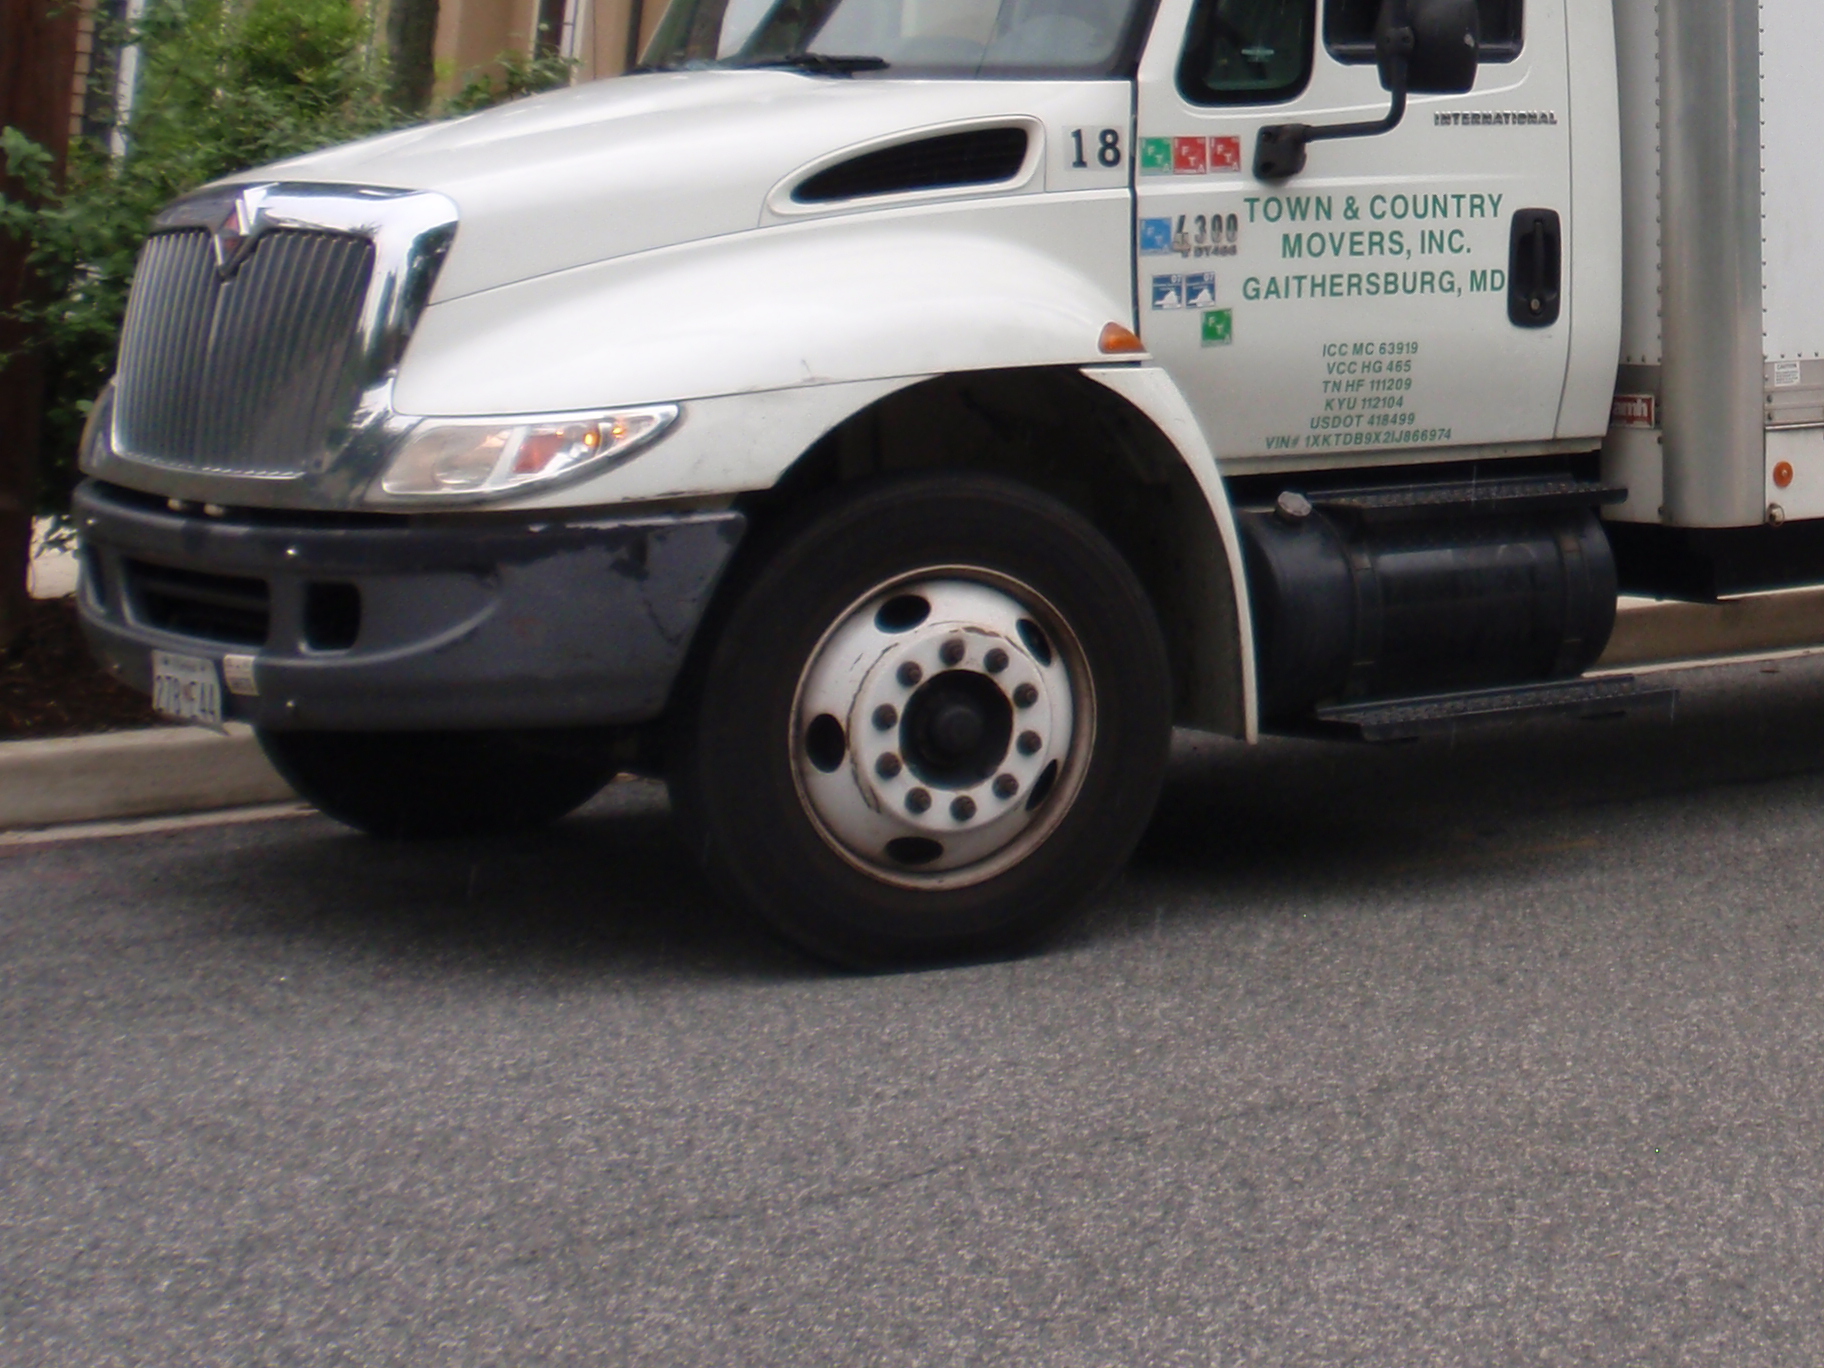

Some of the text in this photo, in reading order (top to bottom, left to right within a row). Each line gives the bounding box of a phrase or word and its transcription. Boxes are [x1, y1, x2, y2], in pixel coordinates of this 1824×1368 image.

[1434, 110, 1558, 127] INTERNATIONAL
[1071, 128, 1121, 169] 18
[1243, 193, 1503, 223] TOWN & COUNTRY
[1281, 229, 1471, 260] MOVERS, INC.
[1242, 269, 1506, 301] GAITHERSBURG, MD
[1322, 341, 1419, 358] ICC MC 63919
[1326, 359, 1412, 375] VCC HG 465
[1322, 377, 1413, 394] TN HF 111209
[1324, 395, 1404, 411] KYU 112104
[1310, 412, 1416, 430] USDOT 418499
